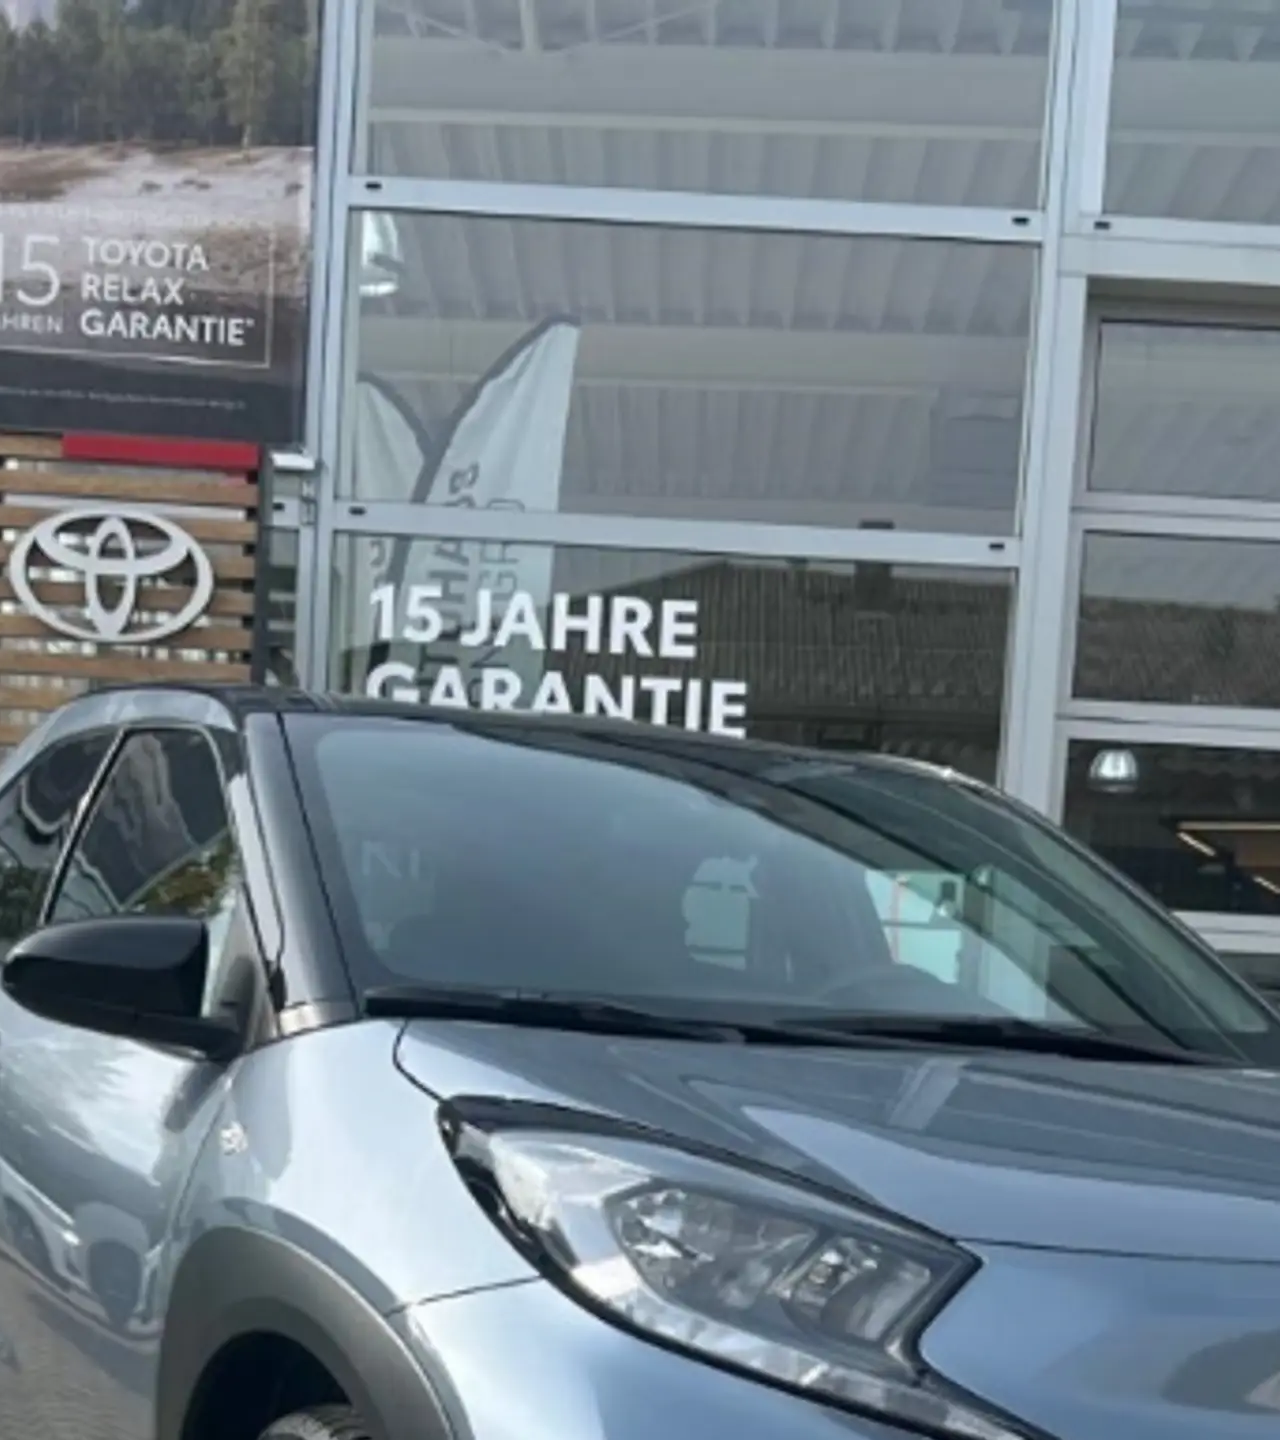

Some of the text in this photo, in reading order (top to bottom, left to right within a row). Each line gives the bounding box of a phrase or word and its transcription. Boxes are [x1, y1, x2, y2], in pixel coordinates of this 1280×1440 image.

[81, 235, 210, 271] TOYOTA
[80, 272, 185, 306] RELAX
[369, 583, 699, 659] 15 JAHRE
[366, 661, 747, 739] GARANTIE
